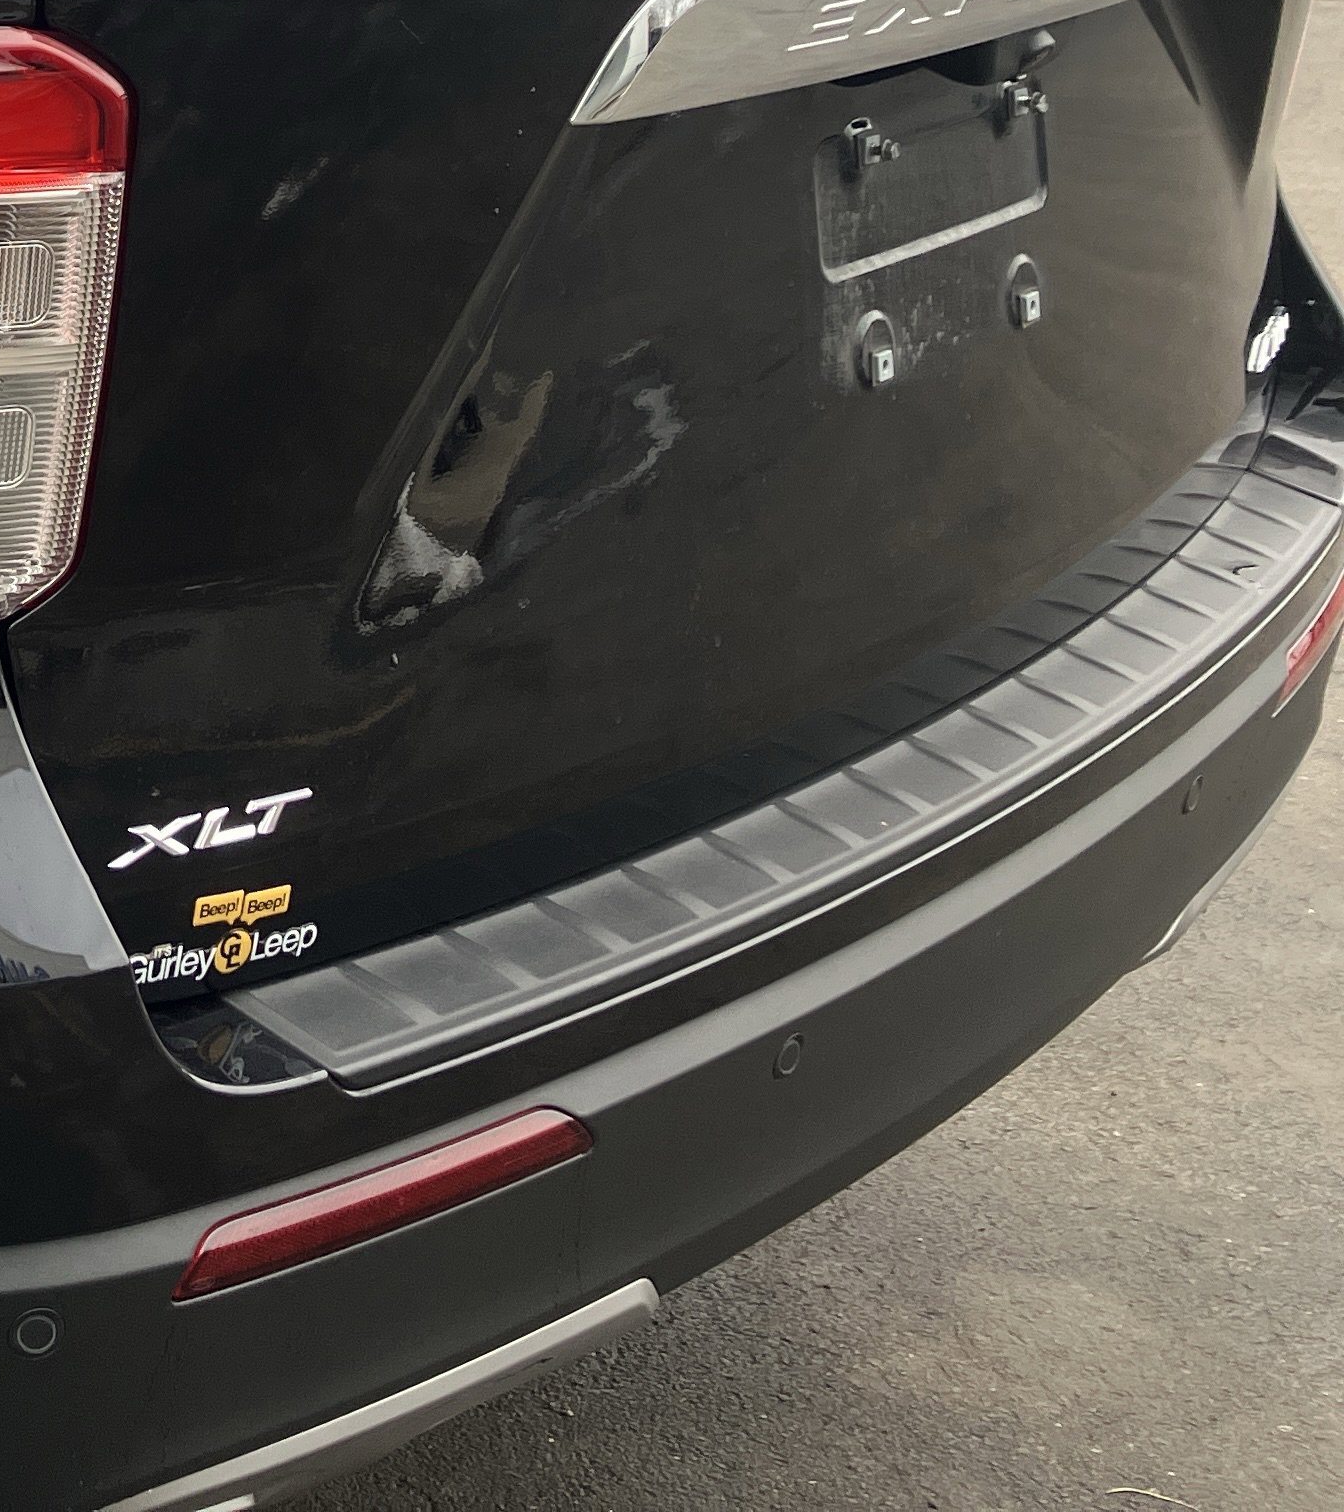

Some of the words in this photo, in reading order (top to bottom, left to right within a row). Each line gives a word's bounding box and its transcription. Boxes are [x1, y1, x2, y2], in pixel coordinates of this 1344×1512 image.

[107, 788, 313, 869] XLT
[199, 897, 240, 919] Beep!
[247, 893, 286, 915] Beep!
[130, 944, 218, 984] Gurley
[250, 924, 318, 962] Leep
